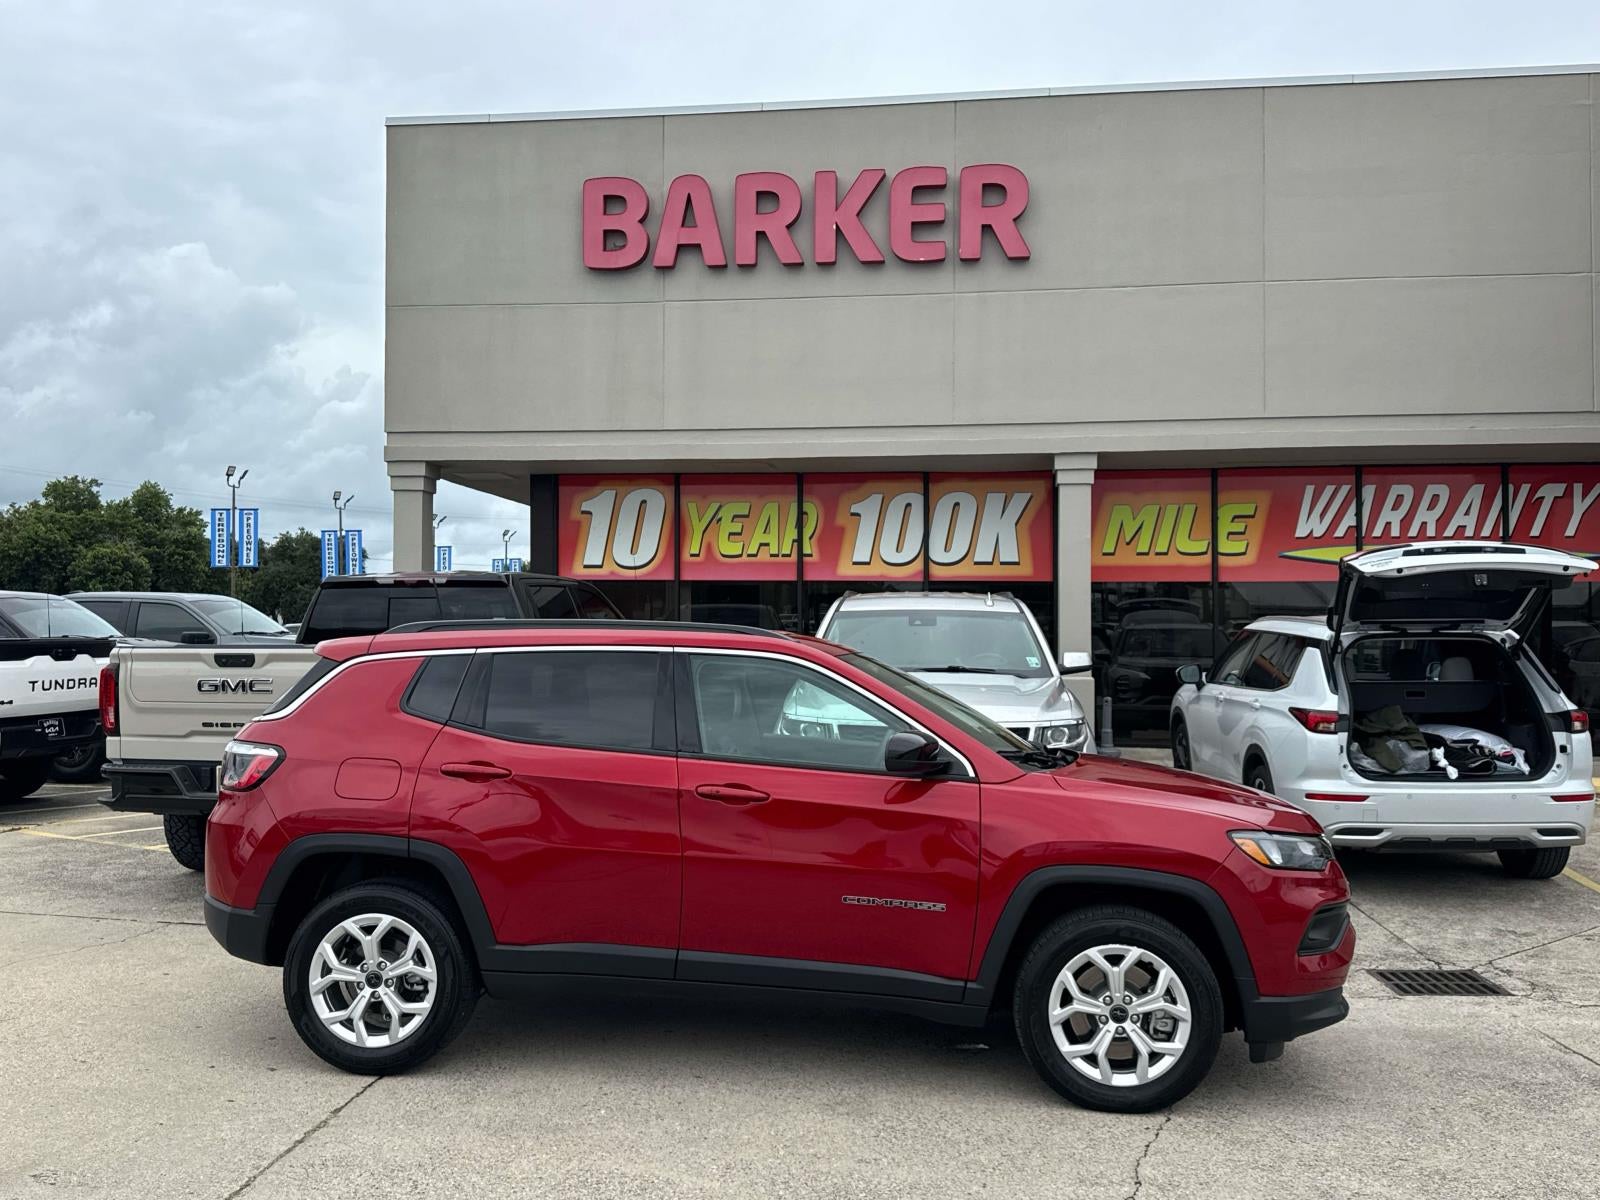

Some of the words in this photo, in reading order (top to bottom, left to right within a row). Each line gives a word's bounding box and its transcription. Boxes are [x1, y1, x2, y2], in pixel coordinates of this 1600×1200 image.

[582, 163, 1031, 270] BARKER
[216, 511, 226, 565] TERREBONNE
[580, 487, 666, 569] 10
[685, 502, 819, 558] YEAR
[849, 491, 1033, 566] 100K
[1101, 502, 1258, 557] MILE
[1293, 483, 1600, 538] WARRANTY
[28, 676, 98, 692] TUNDRA
[197, 677, 274, 694] GMC
[842, 895, 947, 912] COMPASS
